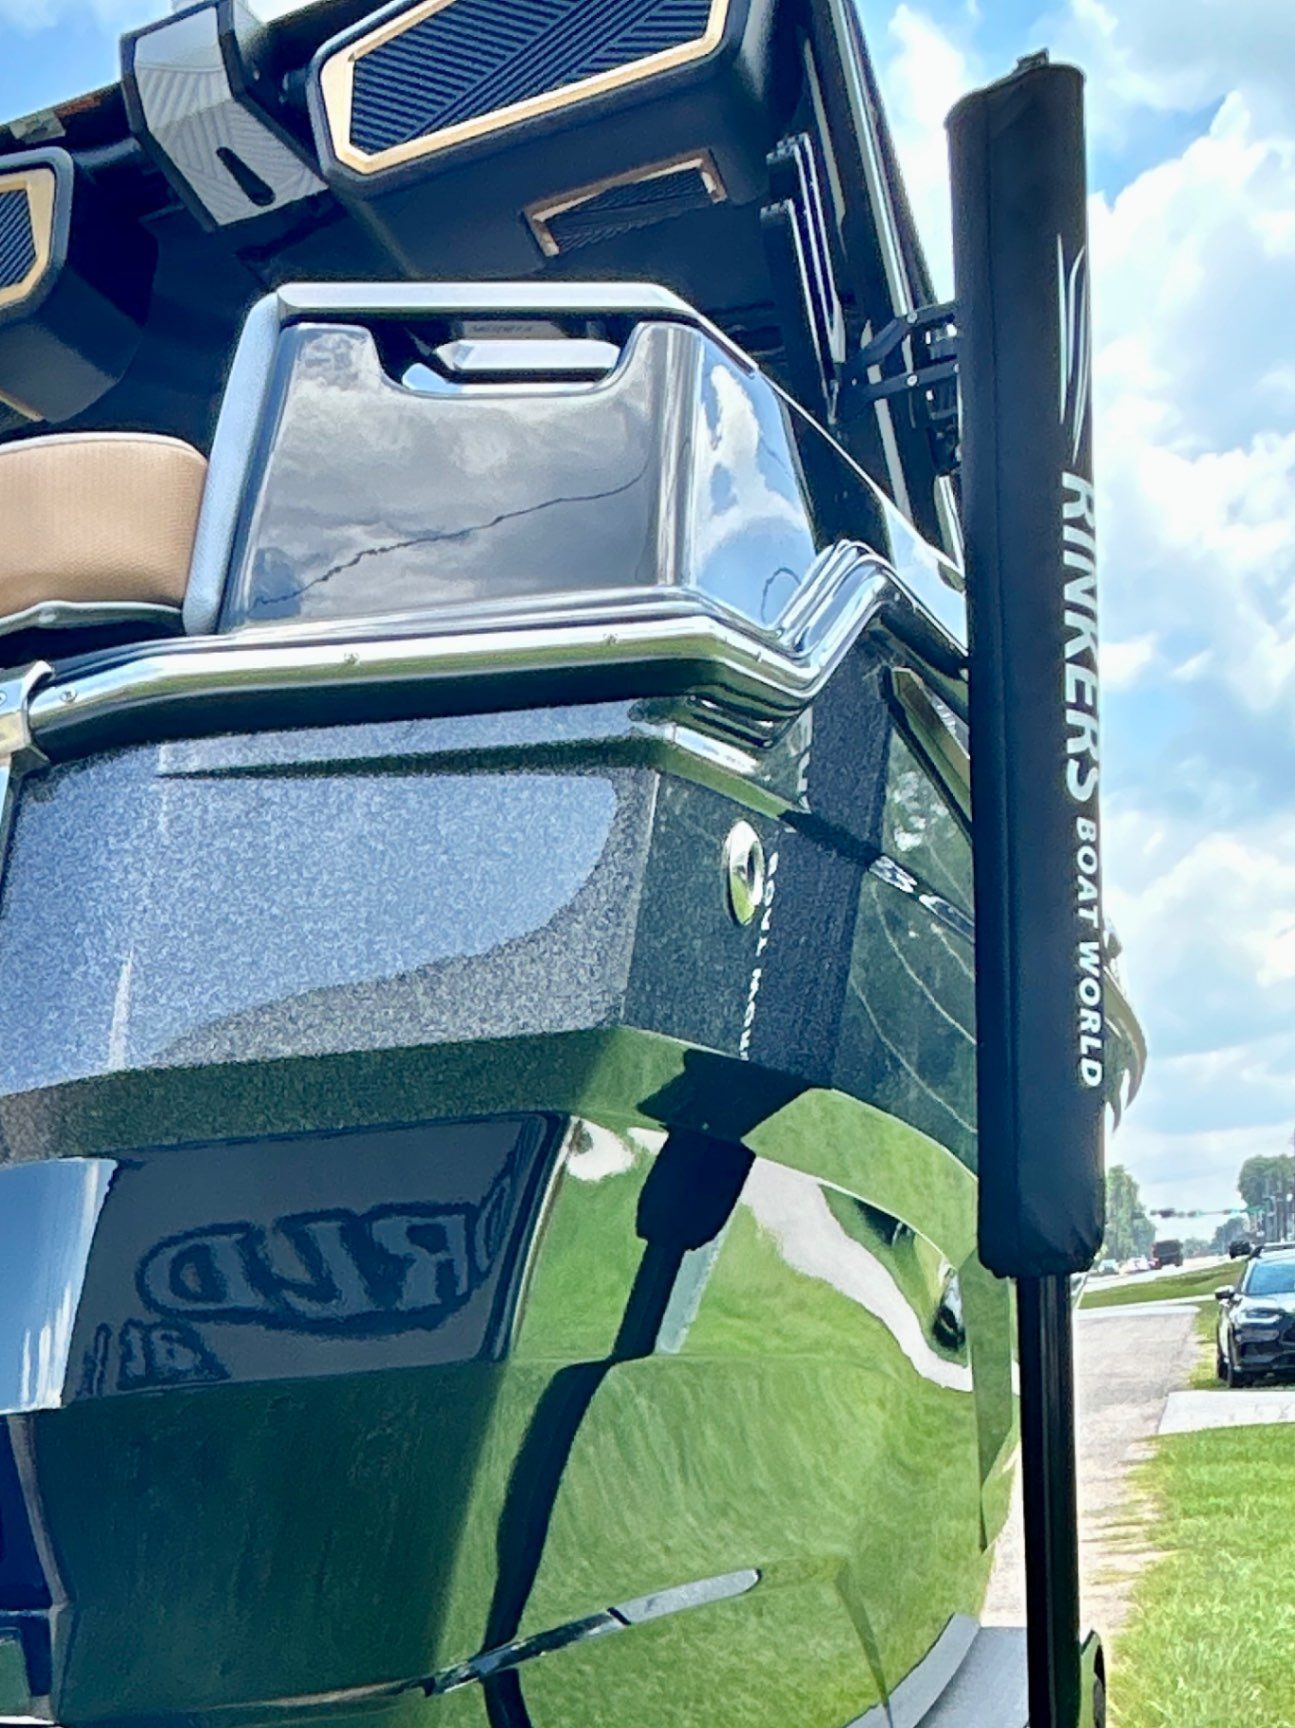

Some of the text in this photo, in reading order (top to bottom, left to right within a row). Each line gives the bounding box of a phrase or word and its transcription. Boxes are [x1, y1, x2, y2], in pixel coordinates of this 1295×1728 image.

[1061, 471, 1103, 1089] RINKERS BOAT WORLD
